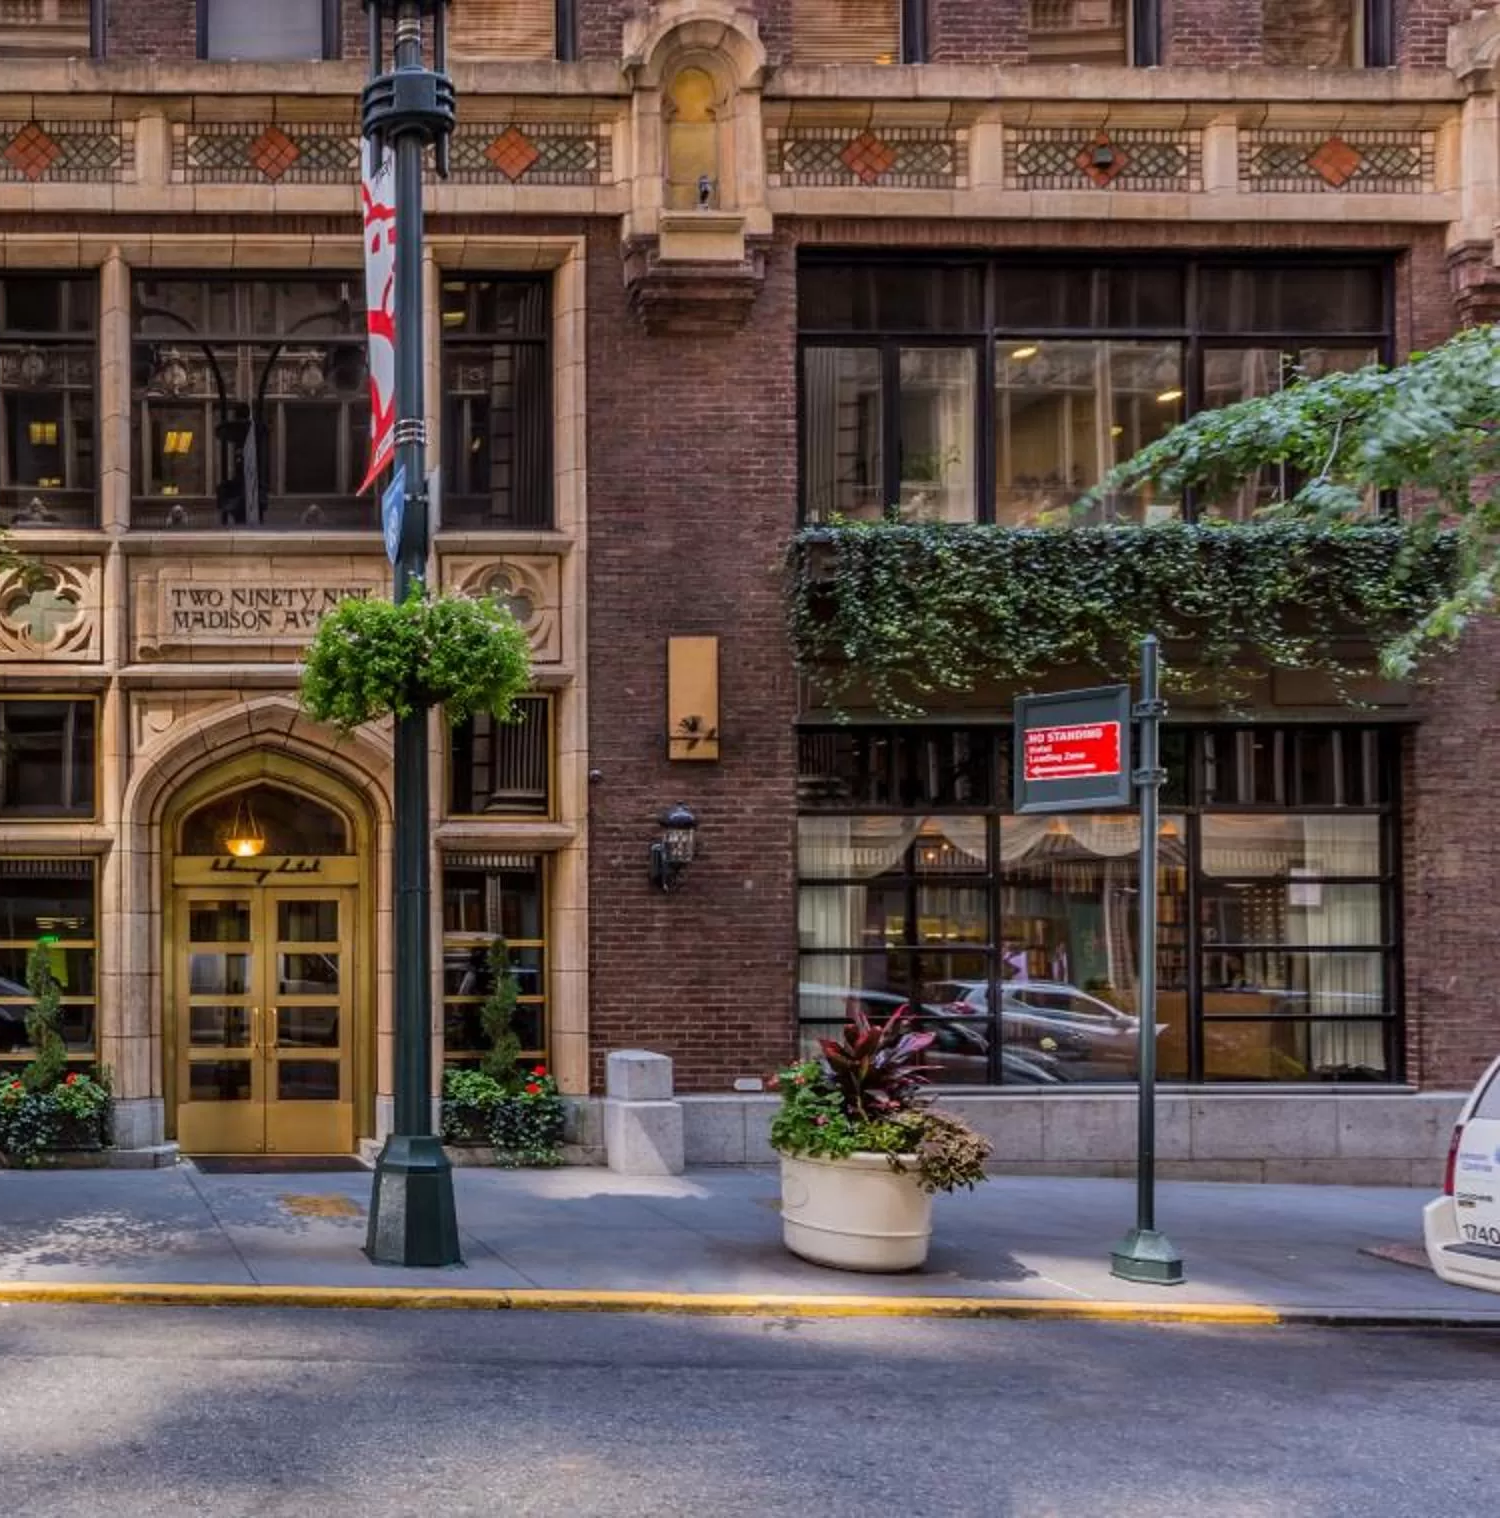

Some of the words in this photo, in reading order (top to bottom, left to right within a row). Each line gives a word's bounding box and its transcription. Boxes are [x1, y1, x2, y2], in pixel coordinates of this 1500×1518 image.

[171, 588, 223, 607] TWO
[230, 588, 316, 607] NINETY
[171, 610, 272, 632] MADISON
[1028, 733, 1045, 743] NO
[1047, 727, 1103, 742] STANDING
